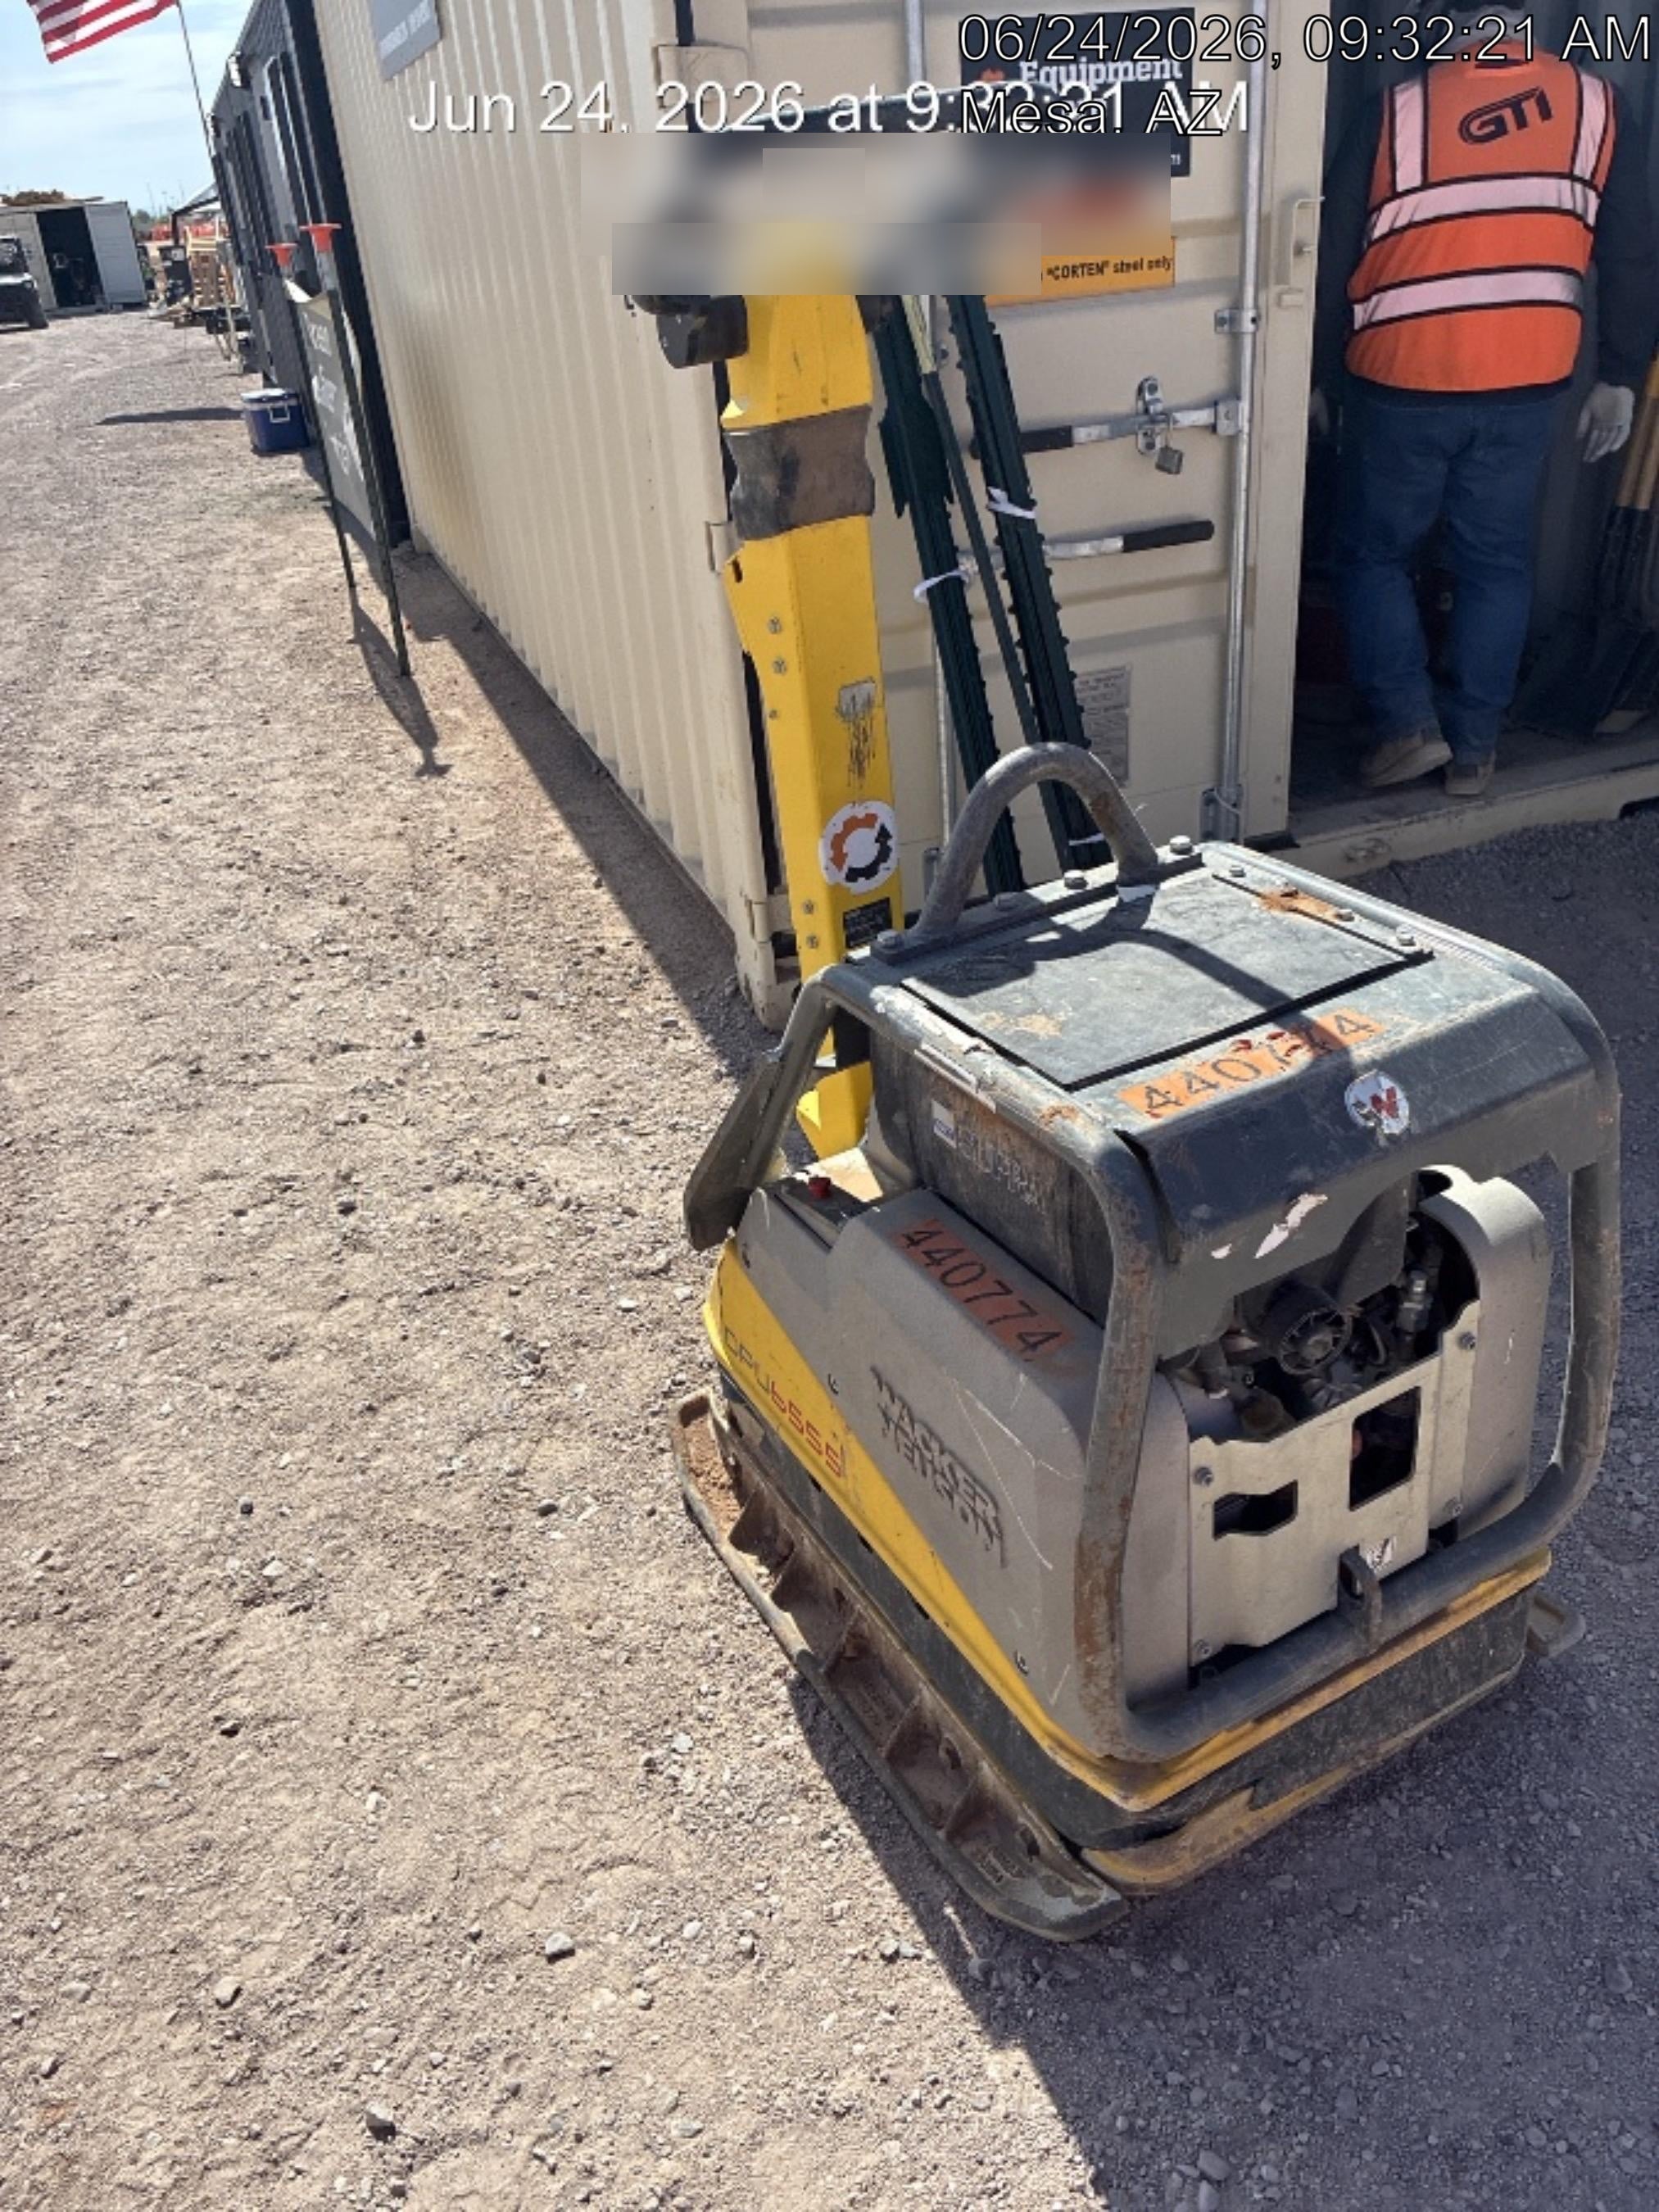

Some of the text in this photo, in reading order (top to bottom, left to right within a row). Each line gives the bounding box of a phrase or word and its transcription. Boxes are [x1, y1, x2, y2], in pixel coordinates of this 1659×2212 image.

[1019, 57, 1183, 93] Equipment
[1458, 87, 1553, 144] GTI
[903, 1230, 1063, 1362] 440774
